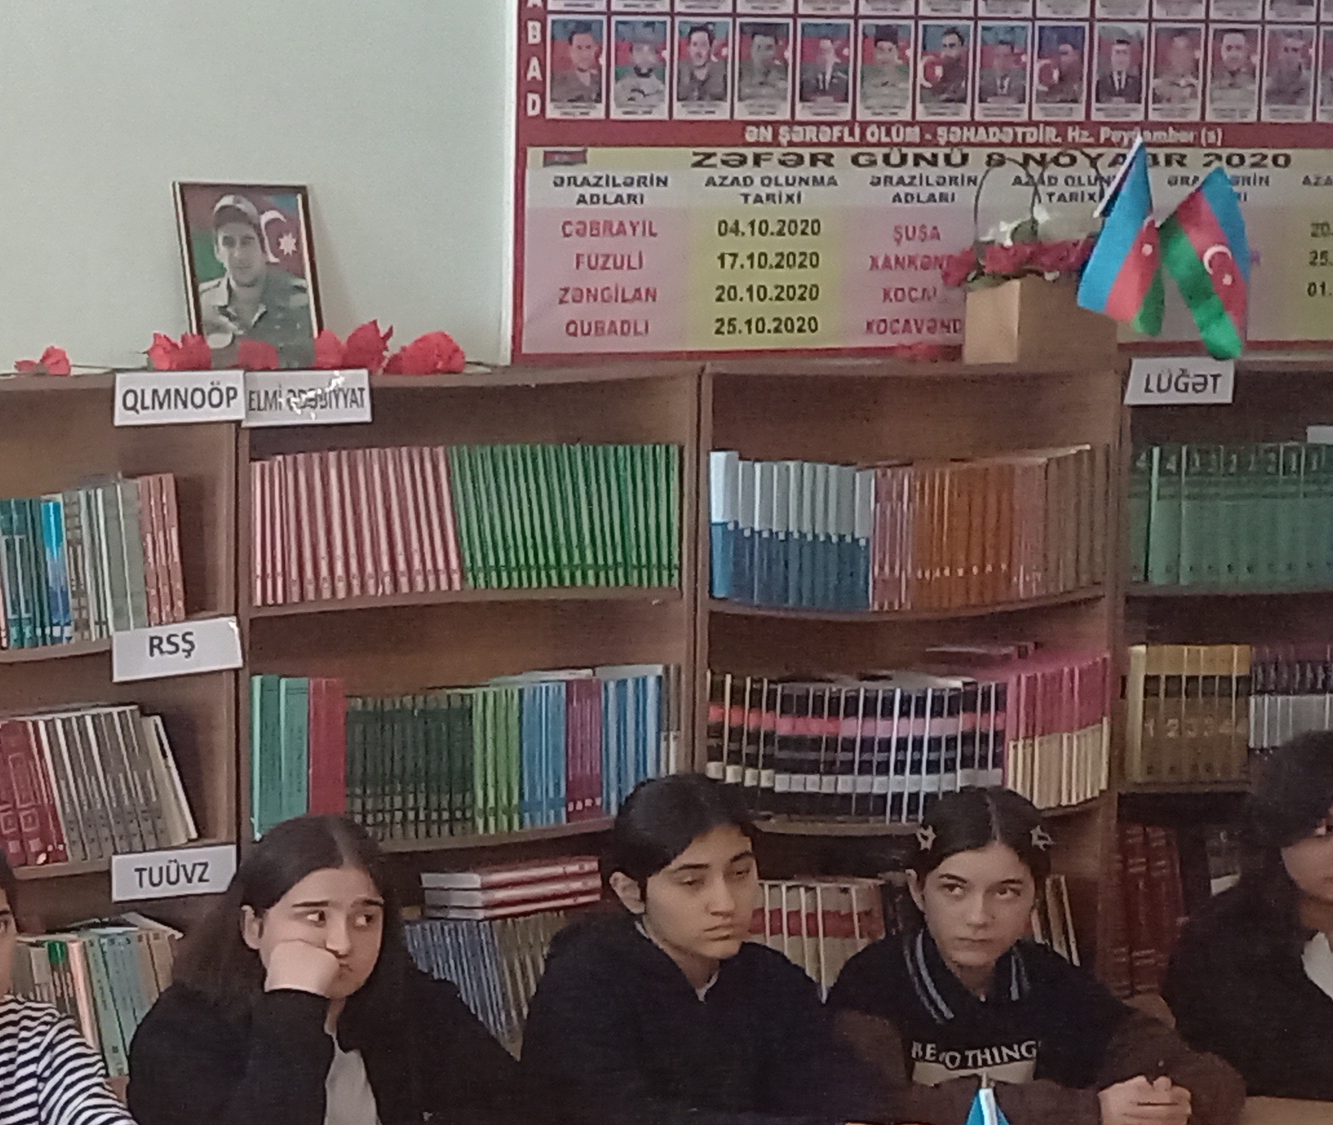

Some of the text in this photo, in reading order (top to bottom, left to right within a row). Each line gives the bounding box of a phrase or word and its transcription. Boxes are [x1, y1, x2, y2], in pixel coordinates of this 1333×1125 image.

[744, 125, 773, 143] ƏN
[690, 151, 835, 168] ZƏFƏR
[850, 147, 969, 169] GÜNÜ
[1201, 151, 1292, 169] 2020
[552, 172, 669, 189] ƏRAZİLƏRİN
[704, 174, 839, 188] AZAD OLUNMA
[869, 171, 978, 188] ƏRAZİLƏRİN
[575, 192, 645, 206] ADLARI
[739, 190, 802, 205] TARİXİ
[891, 190, 956, 205] ADLARI
[716, 218, 822, 238] 04.10.2020
[893, 224, 941, 246] ŞUŞA
[575, 250, 644, 271] FUZULİ
[716, 250, 821, 270] 17.10.2020
[558, 283, 658, 304] ZƏNGİLAN
[714, 283, 820, 303] 20.10.2020
[565, 318, 650, 337] QUBADLI
[713, 316, 820, 336] 25.10.2020
[1144, 369, 1223, 395] LÜĞƏT
[121, 380, 239, 414] QLMNOÖP
[248, 383, 282, 412] ELMİ
[148, 631, 196, 661] RSŞ
[134, 860, 211, 889] TUÜVZ
